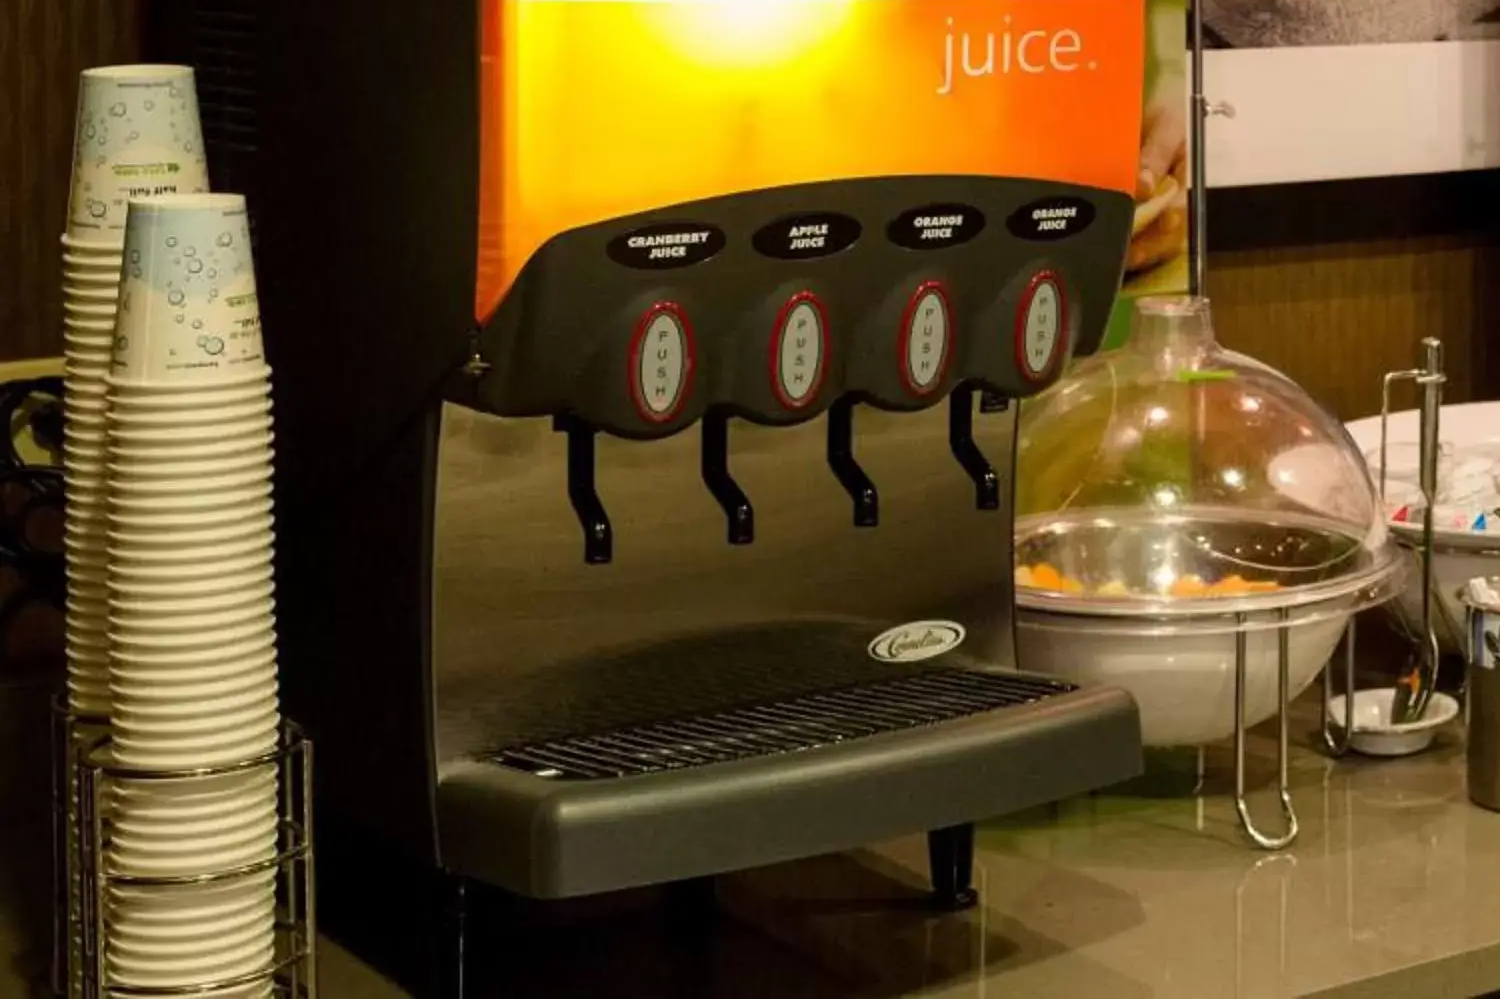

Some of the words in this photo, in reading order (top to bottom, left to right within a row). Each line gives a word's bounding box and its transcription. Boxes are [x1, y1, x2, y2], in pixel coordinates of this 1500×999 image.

[935, 13, 1098, 95] juice.
[913, 214, 964, 228] ORANGE
[1032, 207, 1078, 221] ORANGE
[788, 223, 829, 238] APPLE
[1037, 219, 1067, 232] JUICE
[627, 231, 710, 248] CRANBERRY
[918, 227, 953, 240] JUICE
[789, 236, 826, 250] JUICE
[648, 245, 687, 259] JUICE
[1034, 295, 1048, 359] PUSH
[920, 307, 934, 372] PUSH
[794, 317, 807, 384] PUSH
[655, 330, 668, 398] PUSH
